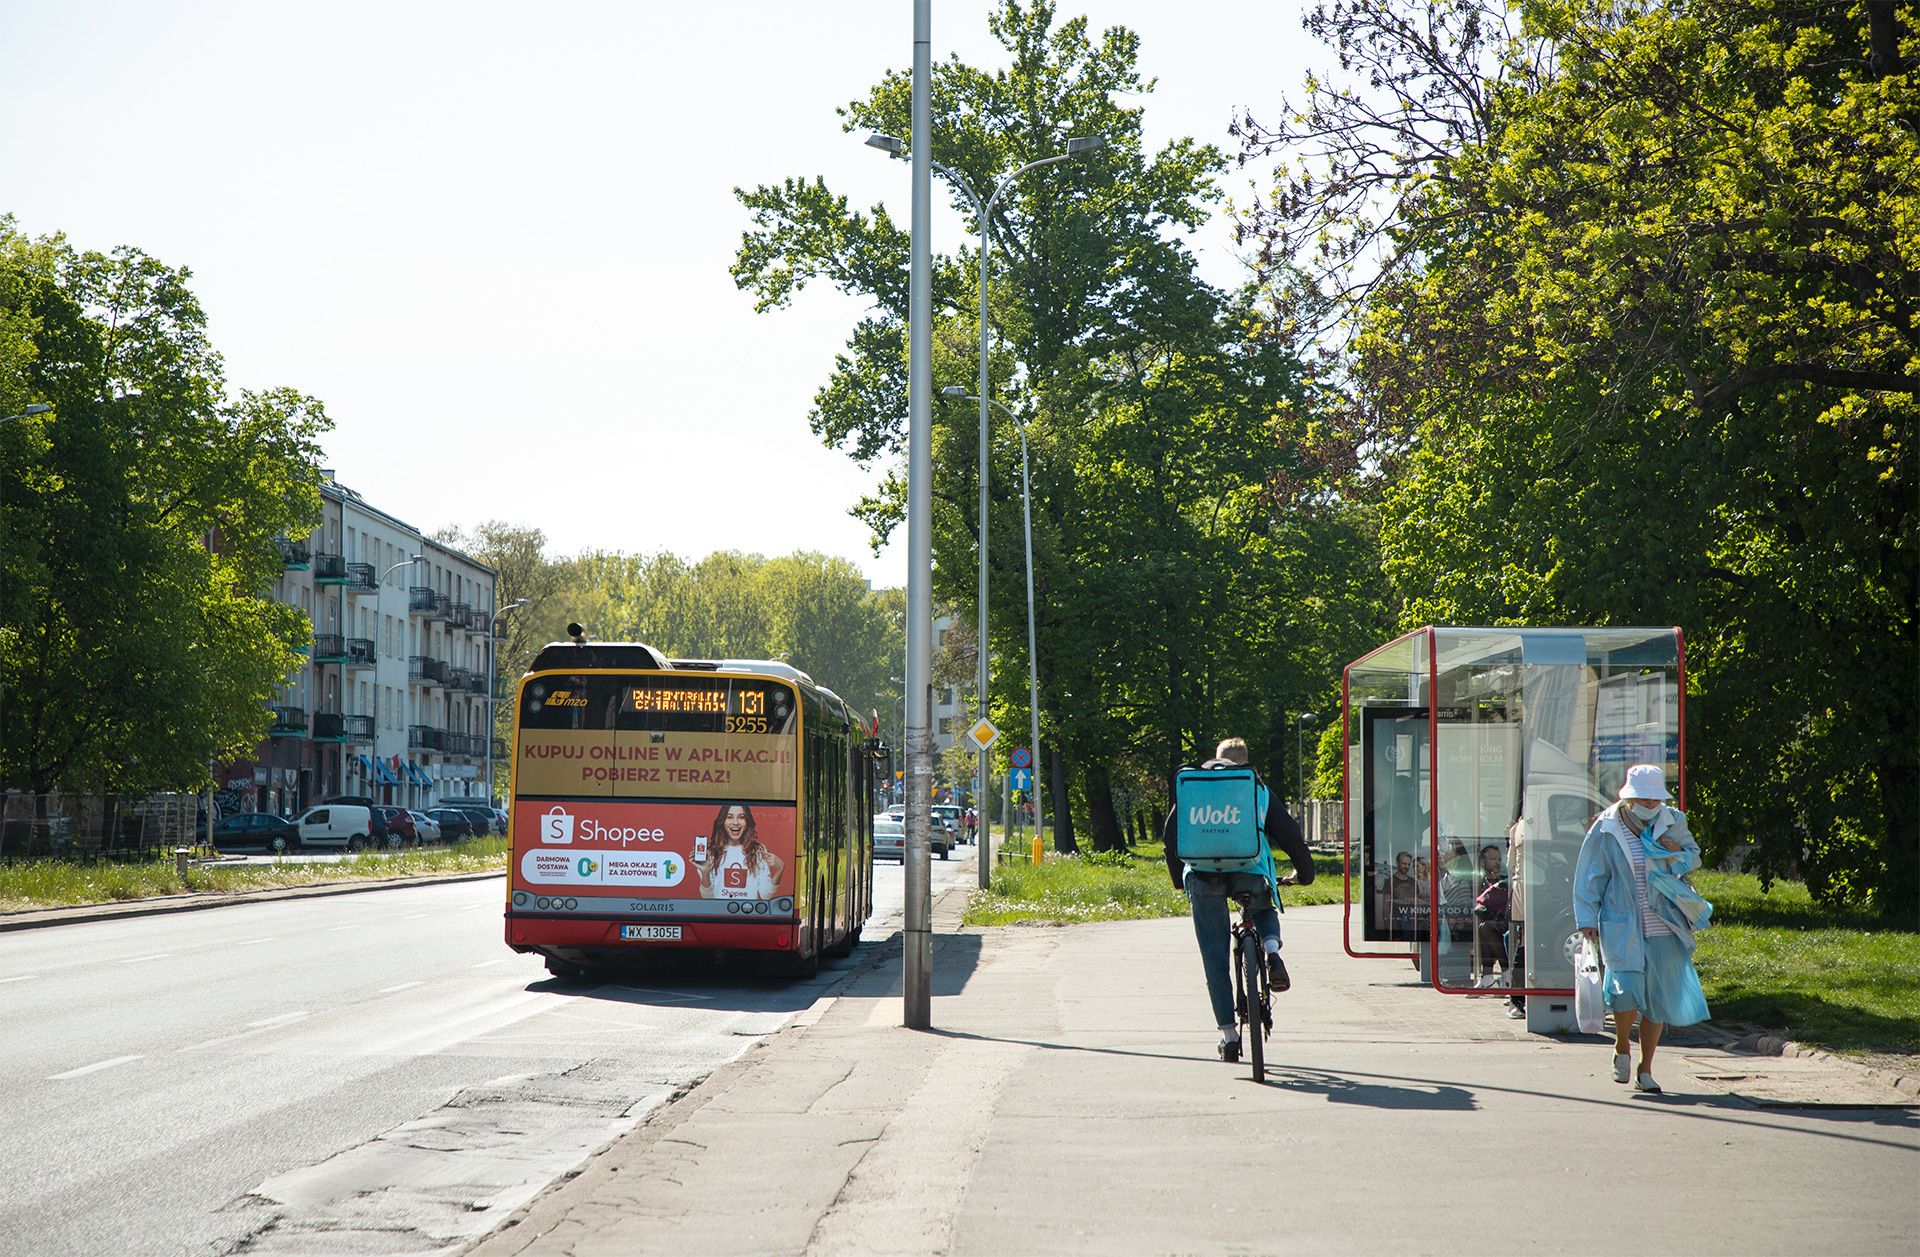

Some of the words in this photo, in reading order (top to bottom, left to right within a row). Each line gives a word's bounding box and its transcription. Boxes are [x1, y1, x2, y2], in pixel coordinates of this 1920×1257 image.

[739, 691, 764, 714] 131
[725, 716, 767, 733] 5255
[525, 745, 584, 759] KUPUJ
[589, 746, 659, 760] ONLINE
[665, 747, 682, 761] W
[688, 748, 790, 764] APLIKACJI!
[582, 766, 660, 782] POBIERZ
[666, 768, 731, 783] TERAZ!
[1189, 804, 1241, 825] Wolt
[580, 819, 665, 848] Shopee
[721, 888, 748, 898] Shopee
[630, 902, 675, 912] SOLARIS
[1398, 906, 1408, 914] W
[1410, 906, 1444, 914] KINAH
[1447, 906, 1461, 914] OD
[1462, 906, 1469, 914] 6
[628, 927, 642, 937] WX
[647, 927, 679, 938] 1305E
